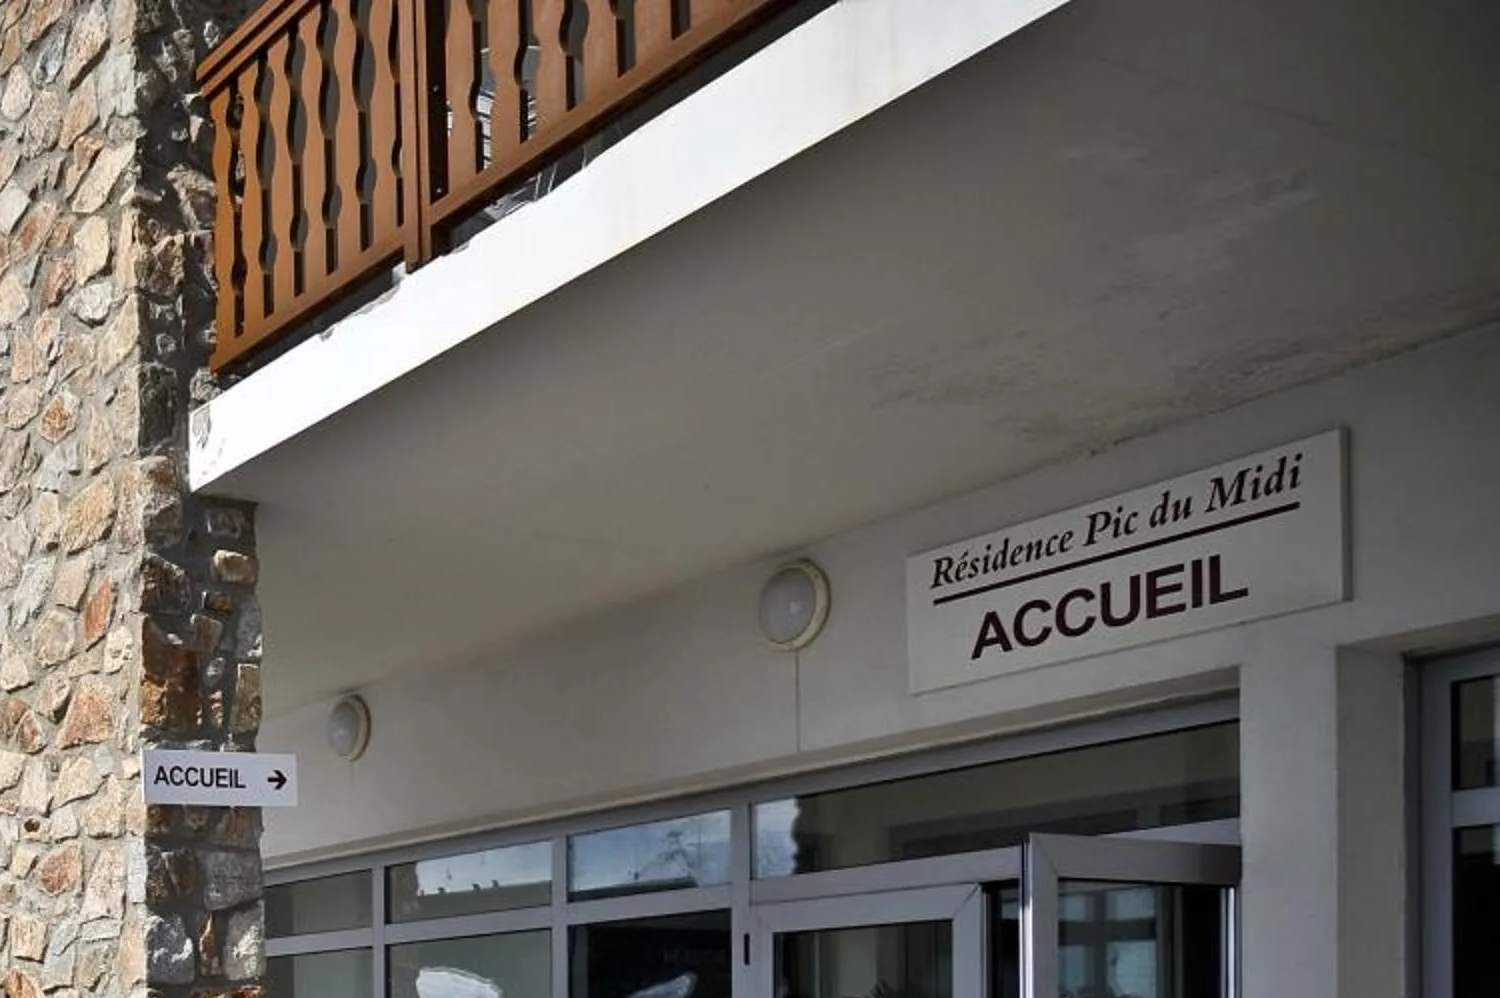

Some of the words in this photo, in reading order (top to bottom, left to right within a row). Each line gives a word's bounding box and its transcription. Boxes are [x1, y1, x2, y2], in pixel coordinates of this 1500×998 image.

[930, 528, 1074, 589] Résidence
[1082, 505, 1139, 547] Pic
[1150, 491, 1193, 527] du
[1204, 453, 1303, 513] Midi
[970, 554, 1249, 660] ACCUEIL
[153, 765, 247, 789] ACCUEIL
